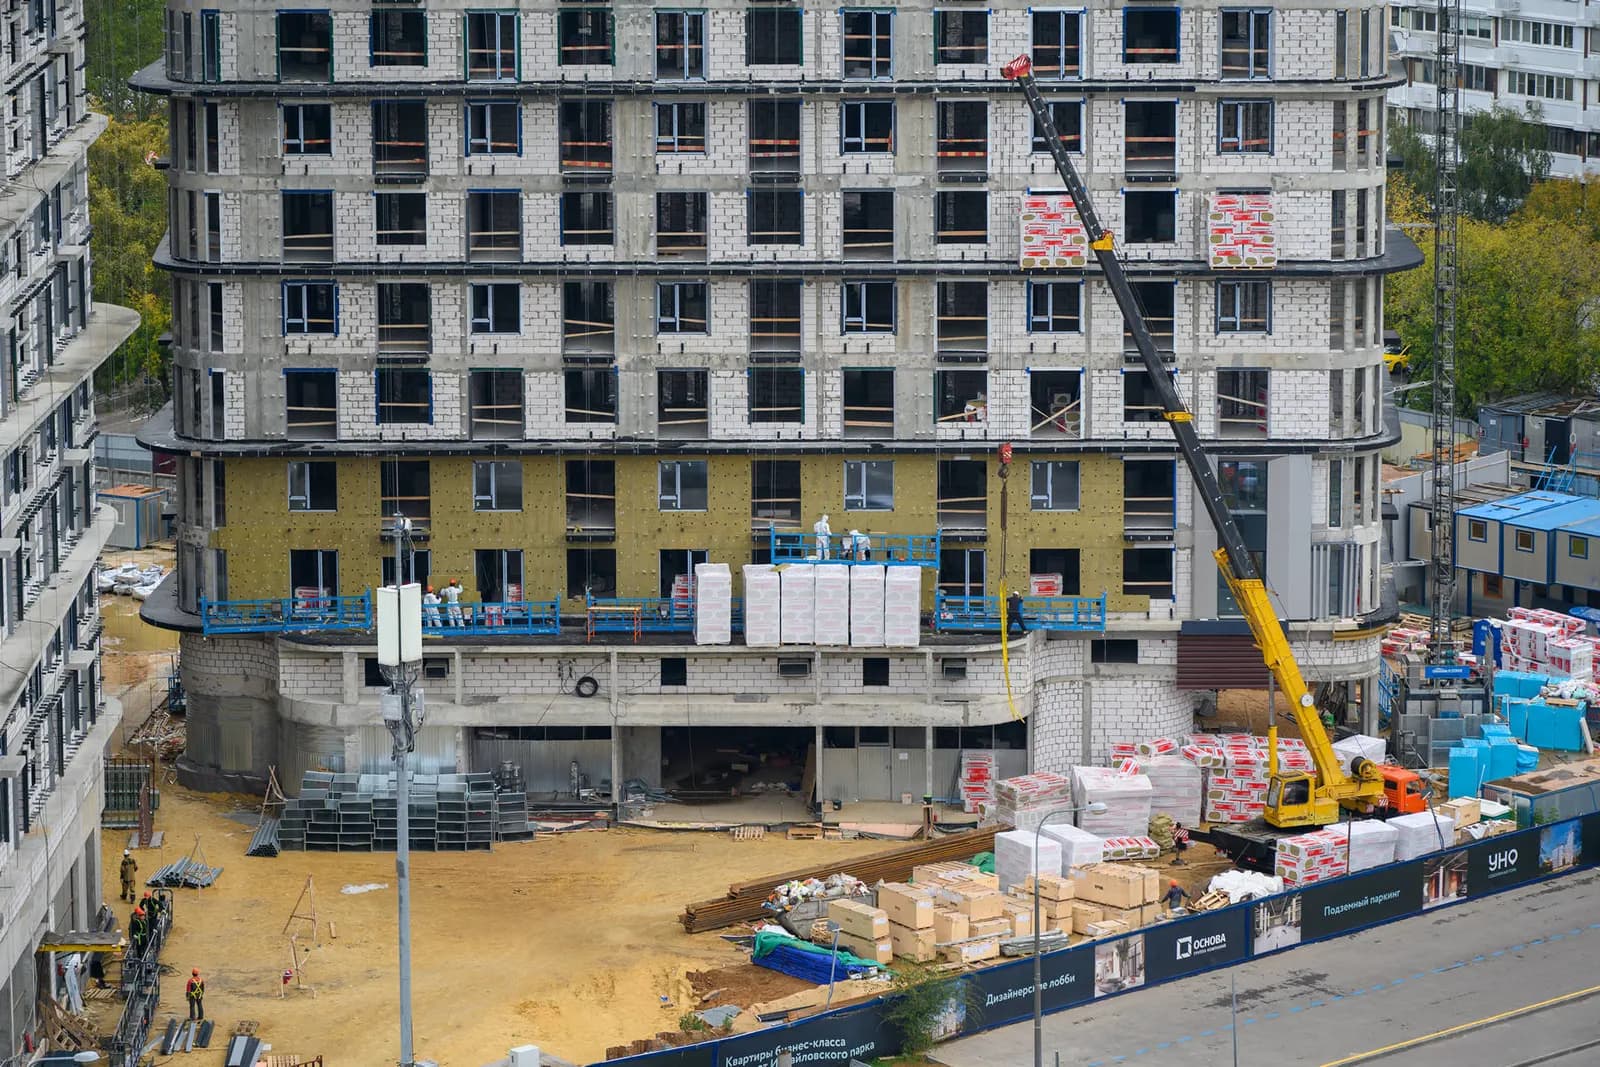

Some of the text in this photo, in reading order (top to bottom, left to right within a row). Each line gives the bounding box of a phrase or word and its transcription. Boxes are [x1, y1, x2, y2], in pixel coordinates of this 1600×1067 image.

[1488, 848, 1518, 871] УНО
[1324, 890, 1400, 916] Подземный паркинг
[1193, 933, 1226, 949] ОСНОВА
[985, 973, 1076, 1006] Дизайнерсе лобби
[725, 1038, 846, 1067] Квартиры бзнес-класса
[770, 1041, 875, 1067] Иайловского парка
